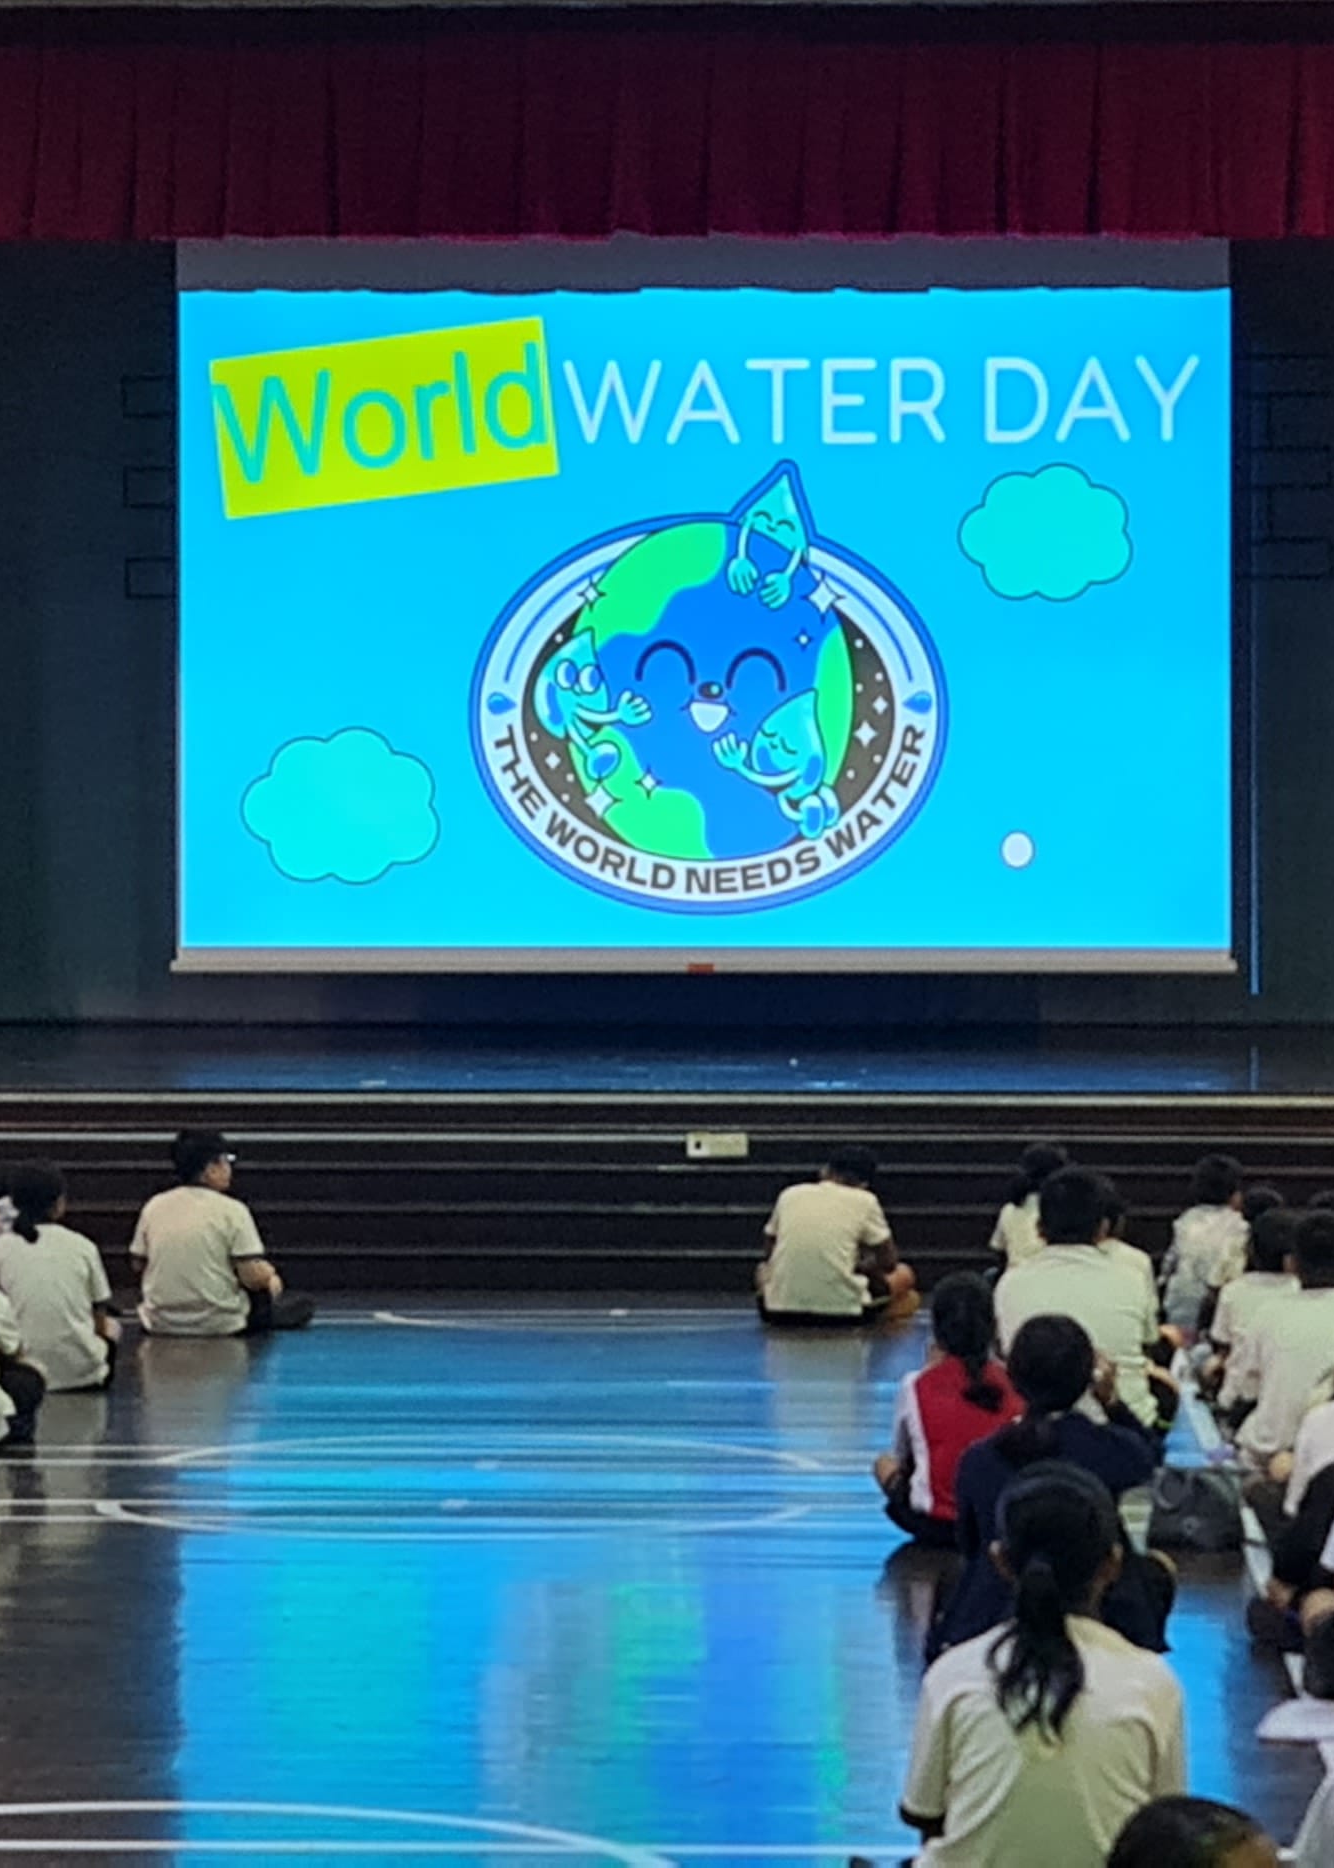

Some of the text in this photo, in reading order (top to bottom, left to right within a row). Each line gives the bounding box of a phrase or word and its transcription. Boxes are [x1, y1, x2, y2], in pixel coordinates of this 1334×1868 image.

[211, 341, 1201, 485] World WATER DAY
[493, 724, 926, 894] THE WORLD NEEDS WATER
